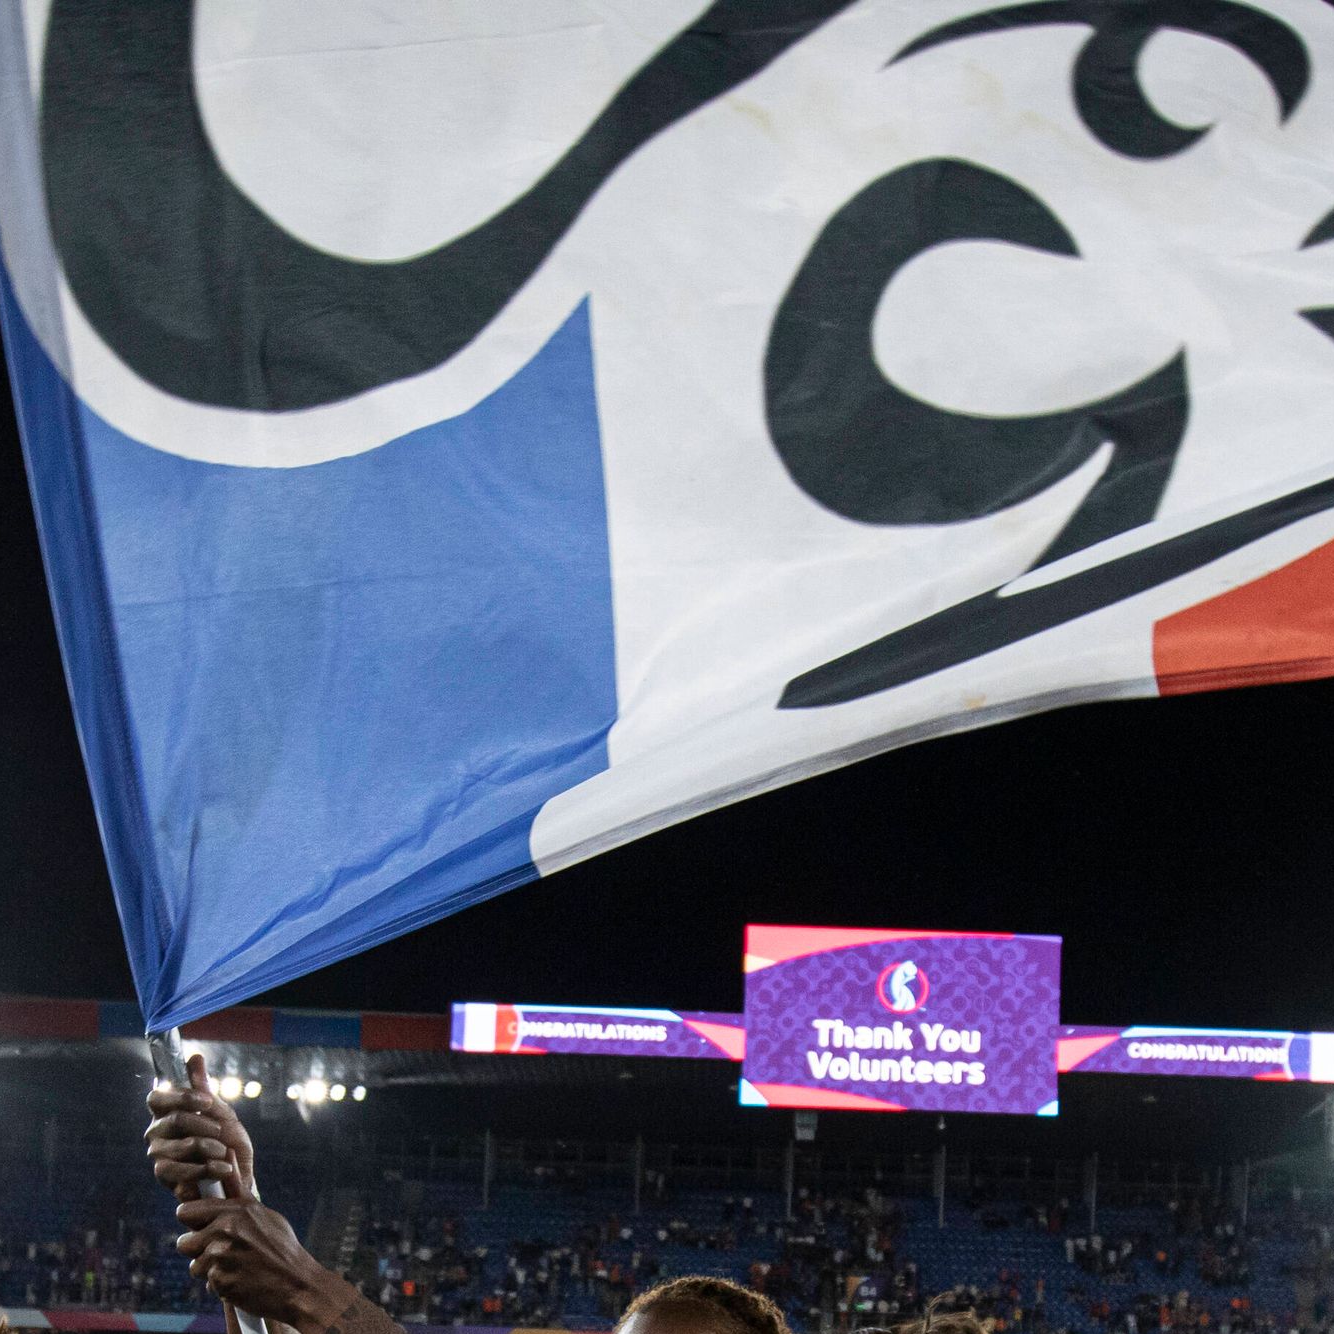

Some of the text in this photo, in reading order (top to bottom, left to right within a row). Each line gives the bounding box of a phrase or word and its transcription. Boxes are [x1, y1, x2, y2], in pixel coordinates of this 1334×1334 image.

[508, 1020, 667, 1042] CONGRATULATIONS
[812, 1019, 982, 1053] Thank You
[1127, 1041, 1288, 1064] CONGRATULATIONS
[807, 1051, 986, 1085] Volunteers
